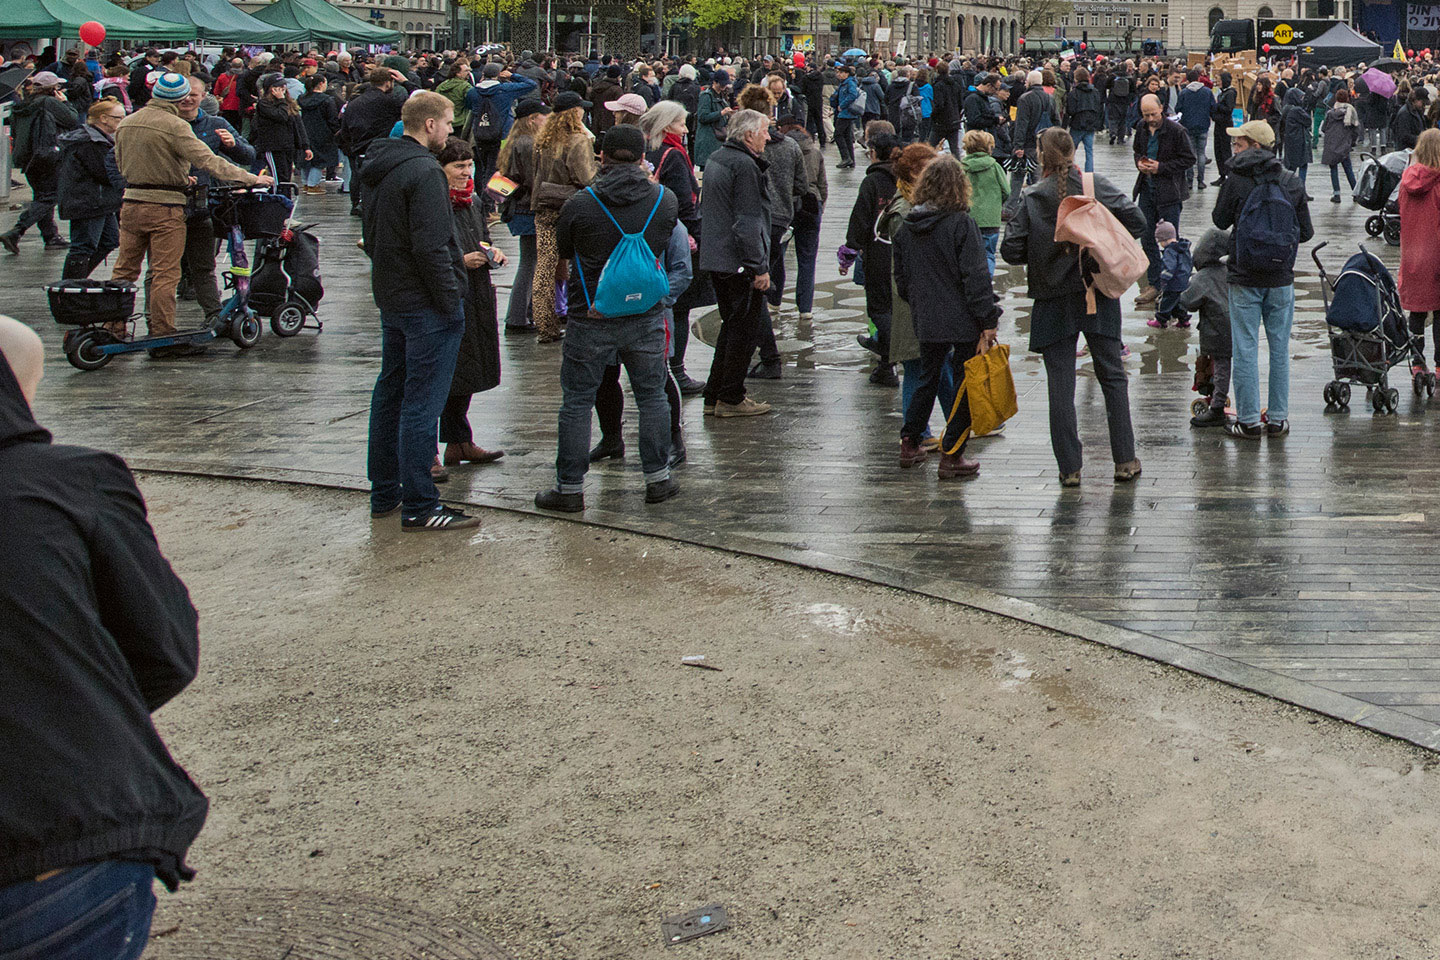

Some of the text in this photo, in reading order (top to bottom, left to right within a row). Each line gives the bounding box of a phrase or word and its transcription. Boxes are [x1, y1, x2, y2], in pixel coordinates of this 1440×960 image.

[1408, 4, 1431, 16] JIN
[1261, 29, 1304, 38] smARTec
[790, 42, 816, 52] ABOS
